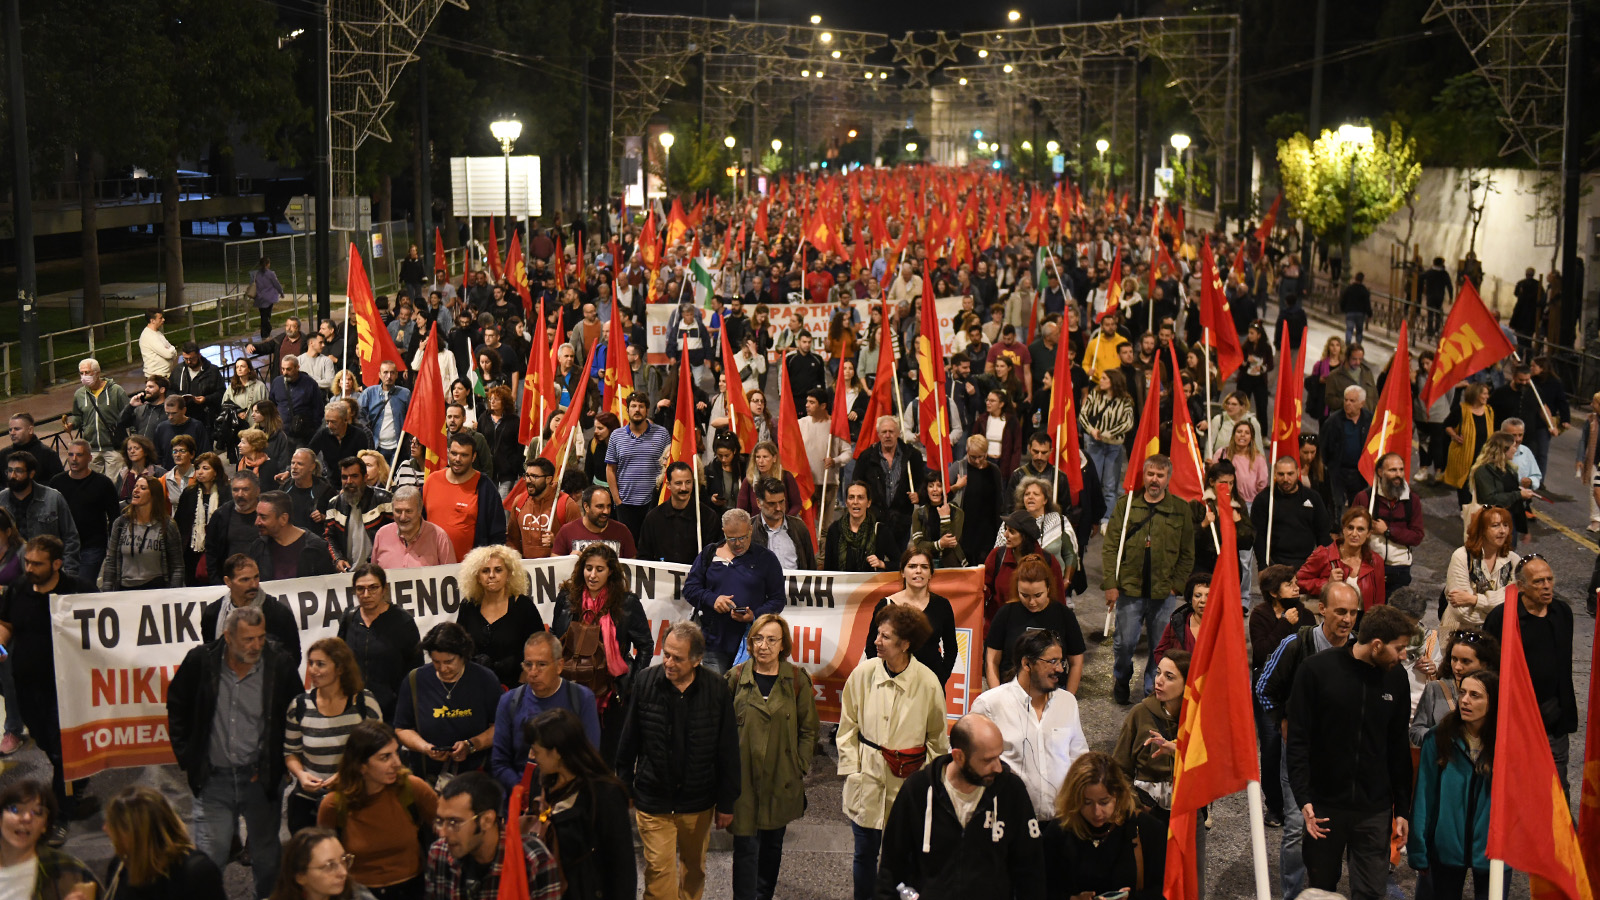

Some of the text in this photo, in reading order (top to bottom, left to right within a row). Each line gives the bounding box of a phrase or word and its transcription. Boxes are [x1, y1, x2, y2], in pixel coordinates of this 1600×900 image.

[73, 606, 120, 650] ΤΟ
[136, 600, 208, 647] ΔΙΚ
[81, 724, 170, 752] ΤΟΜΕΑ
[1027, 818, 1041, 839] 8
